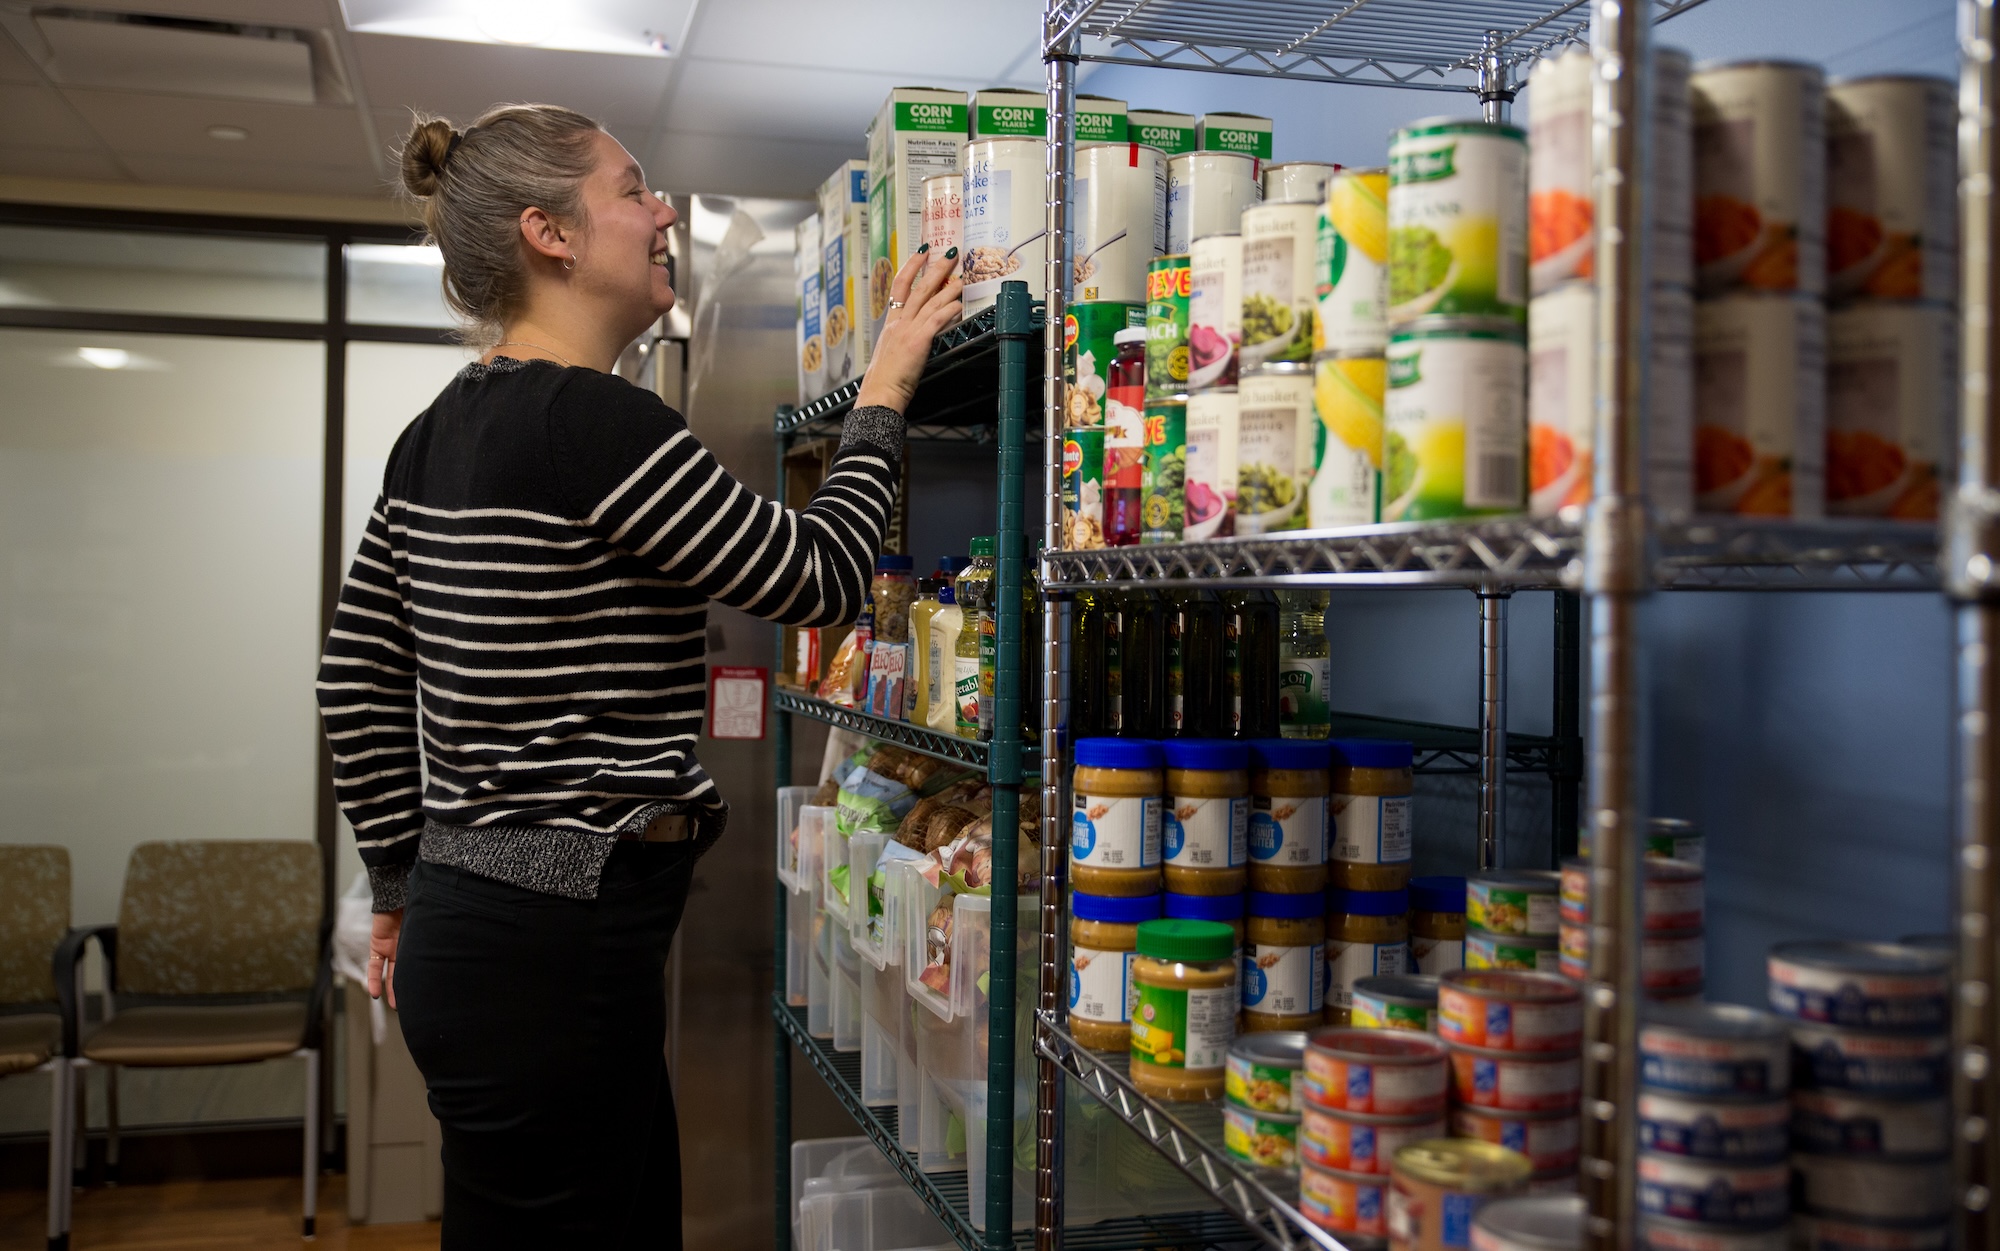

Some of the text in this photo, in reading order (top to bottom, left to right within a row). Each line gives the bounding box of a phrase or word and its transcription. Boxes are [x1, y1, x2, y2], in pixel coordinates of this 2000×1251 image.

[910, 105, 952, 118] CORN
[992, 108, 1034, 121] CORN
[1075, 114, 1113, 127] CORN
[1141, 128, 1181, 141] CORN
[1219, 131, 1258, 144] CORN
[949, 193, 961, 205] &
[923, 205, 961, 222] basket
[928, 238, 952, 249] OATS
[1287, 672, 1306, 685] Oil
